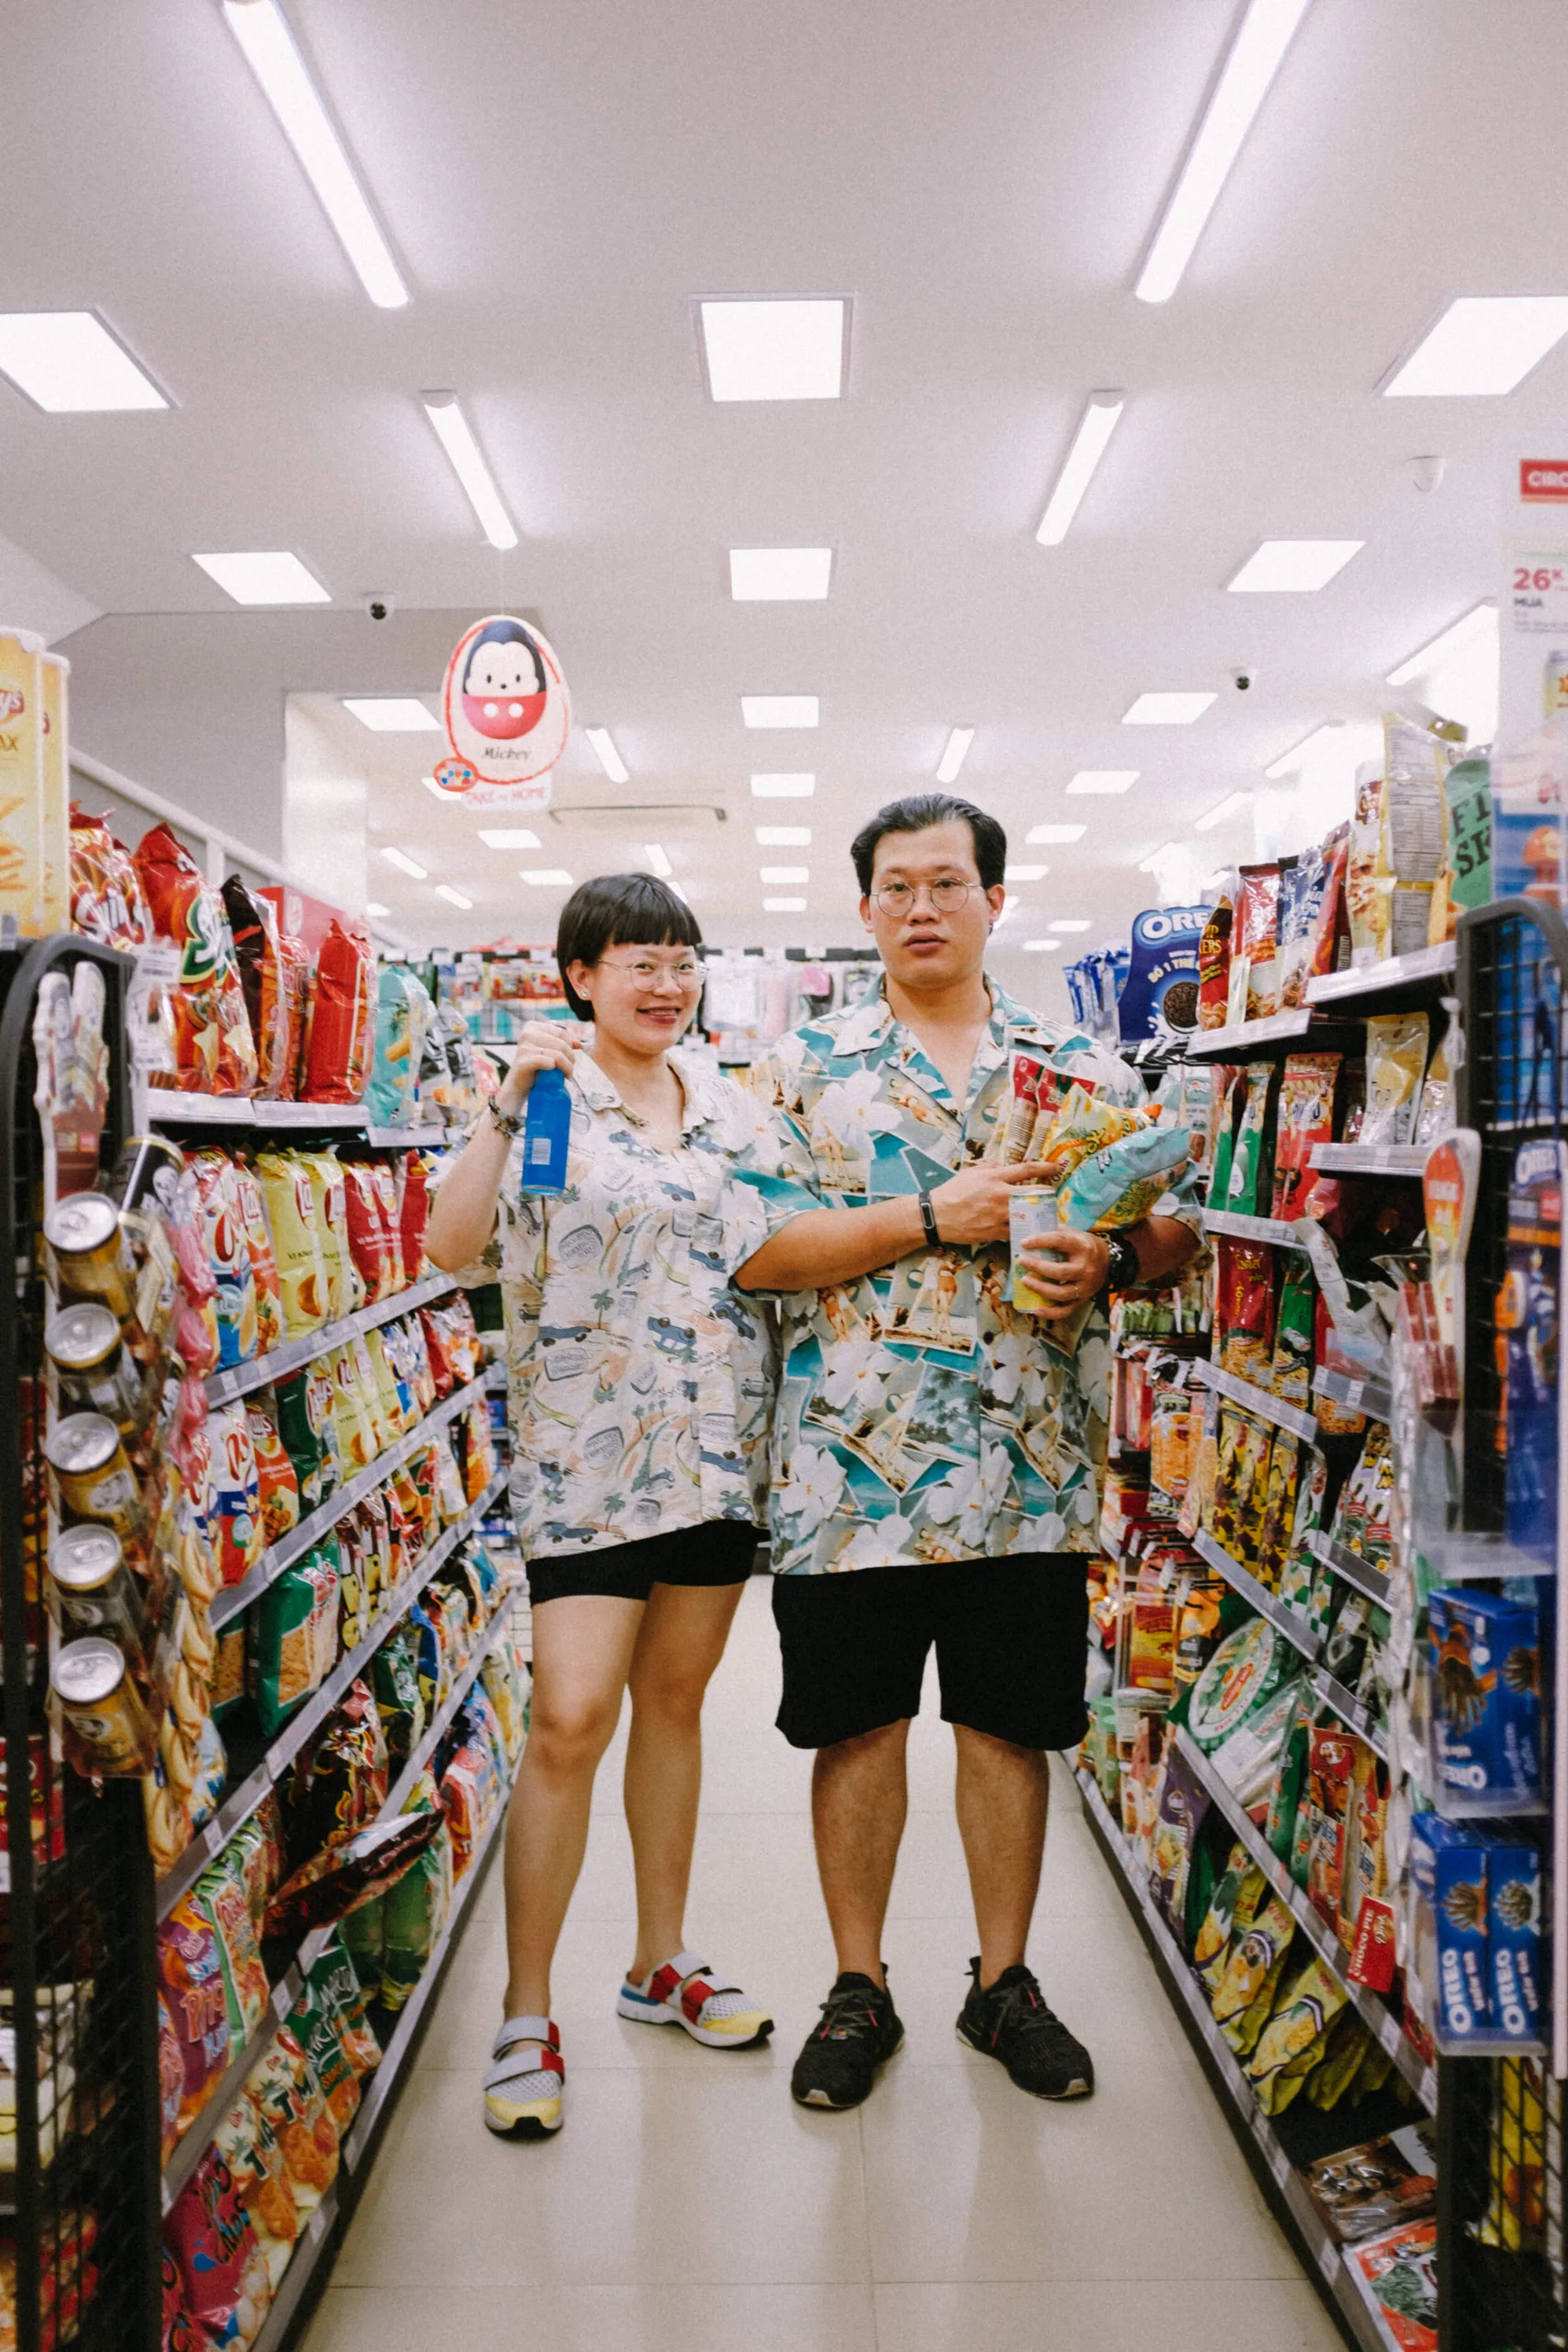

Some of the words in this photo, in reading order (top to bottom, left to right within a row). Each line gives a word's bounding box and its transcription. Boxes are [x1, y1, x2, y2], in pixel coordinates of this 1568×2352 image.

[483, 746, 529, 762] Mickey
[1142, 911, 1209, 939] ORE
[1052, 1159, 1070, 1182] Oishi
[1351, 1932, 1368, 1977] CHOCO
[1495, 1948, 1526, 2034] OREO
